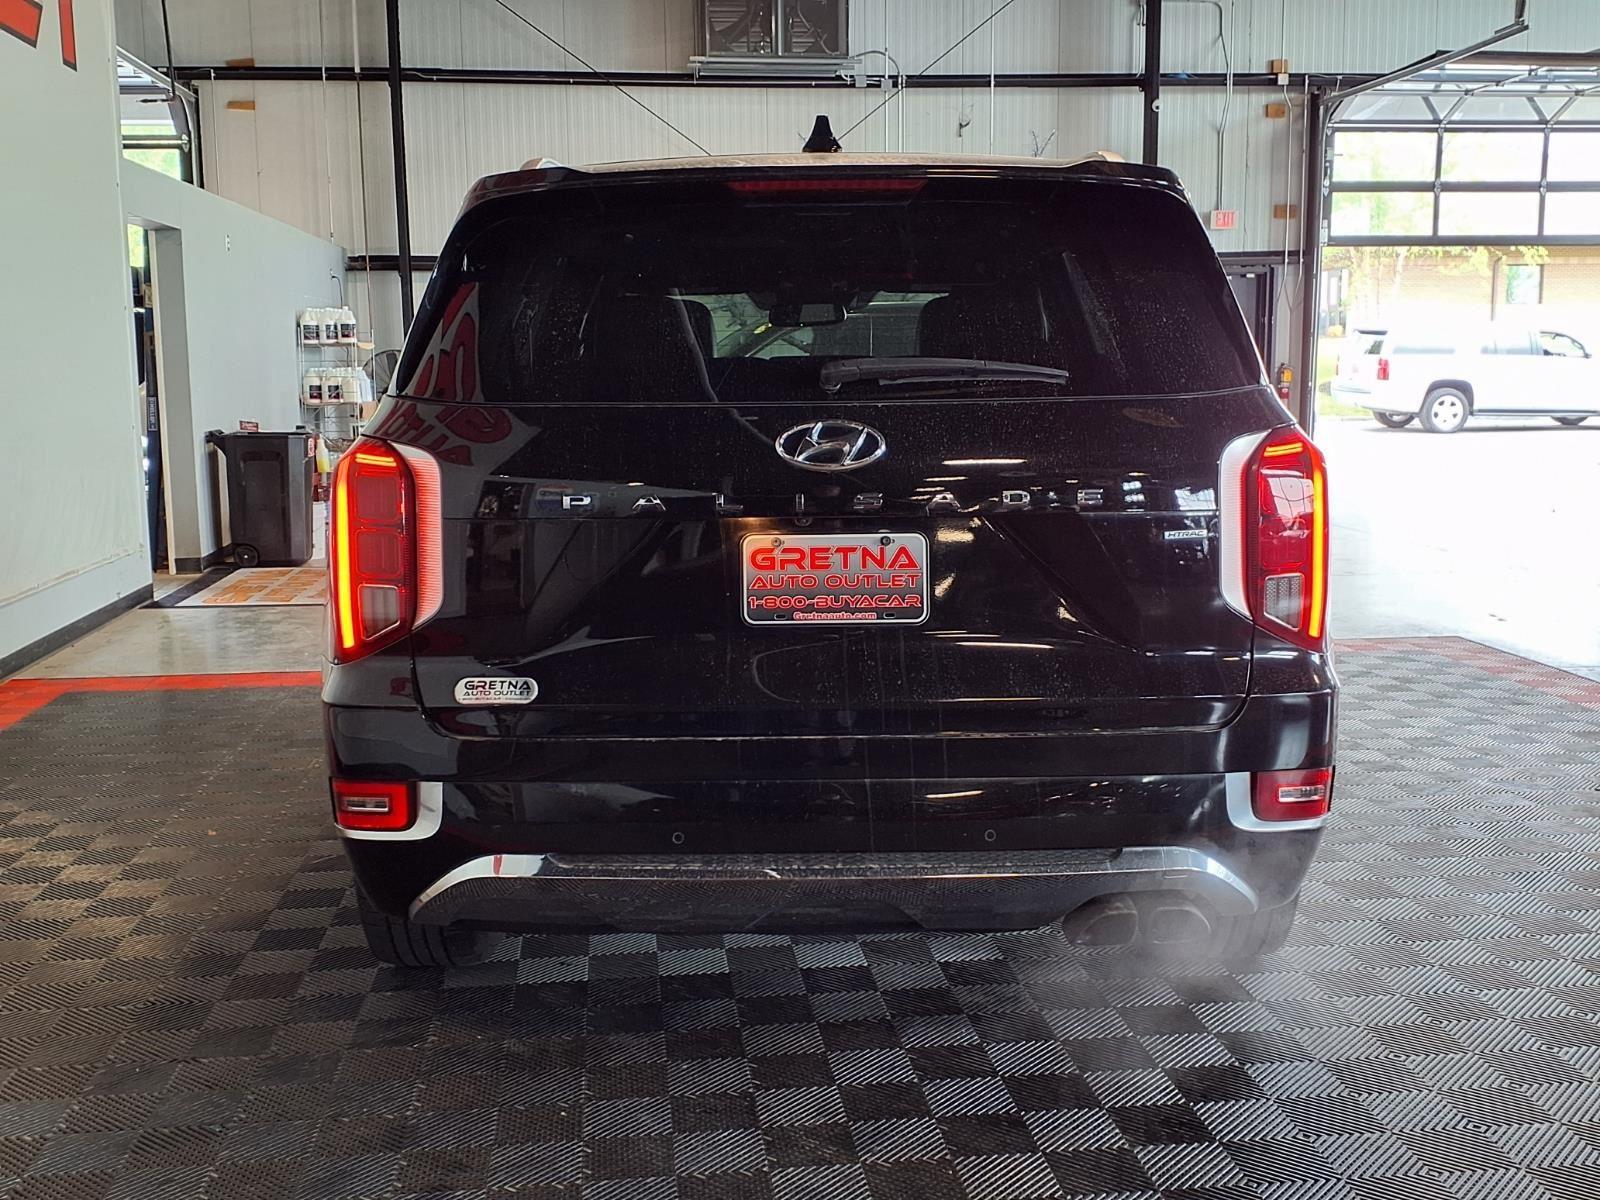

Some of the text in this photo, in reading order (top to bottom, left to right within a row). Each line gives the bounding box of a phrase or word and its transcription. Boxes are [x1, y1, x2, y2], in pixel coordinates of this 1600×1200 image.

[1215, 211, 1234, 227] EXIT
[562, 488, 1104, 510] PALISADE
[1167, 530, 1206, 538] HTRAC
[750, 545, 921, 571] GRETNA
[749, 573, 922, 589] AUTO OUTLET
[749, 594, 922, 609] 1-800-BUYACAR
[793, 611, 877, 621] Gretnaauto.com
[464, 680, 532, 690] GRETNA
